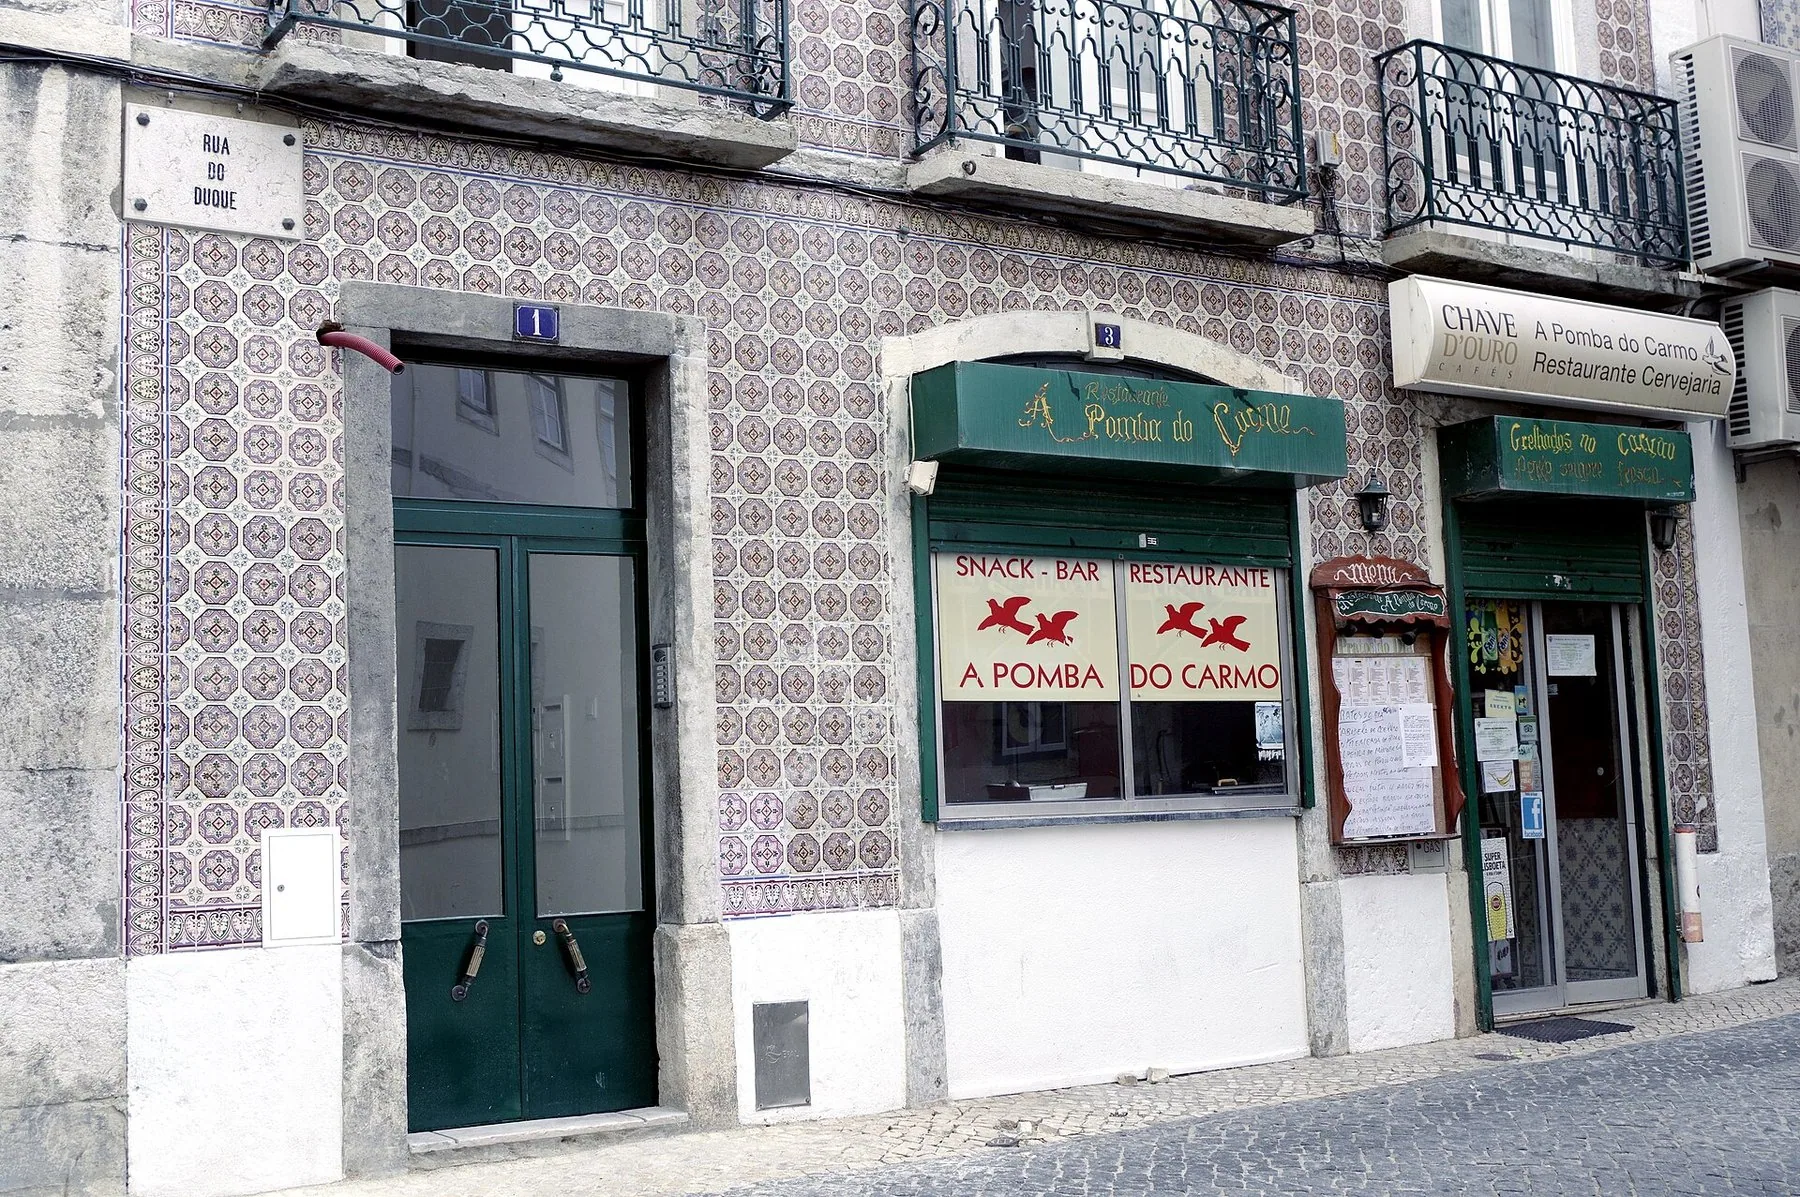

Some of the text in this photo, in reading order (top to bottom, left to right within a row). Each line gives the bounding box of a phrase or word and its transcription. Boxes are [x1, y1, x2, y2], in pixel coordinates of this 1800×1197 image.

[203, 134, 230, 155] RUA
[208, 162, 225, 181] DO
[194, 187, 237, 210] DUQUE
[532, 309, 542, 336] 1
[1442, 304, 1518, 338] CHAVE
[1104, 326, 1114, 346] 3
[1443, 333, 1518, 365] D'OURO
[1535, 320, 1698, 361] A Pomba do Carmo
[1533, 351, 1721, 396] Restaurante Cervejaria
[1083, 403, 1162, 444] Pomba
[1172, 410, 1193, 442] do
[1510, 423, 1573, 454] Grelhados
[956, 555, 1034, 579] SNACK
[1056, 561, 1100, 582] BAR
[1130, 563, 1270, 588] RESTAURANTE
[960, 662, 1104, 689] A POMBA
[1130, 663, 1280, 690] DO CARMO
[1484, 852, 1502, 861] SUPER
